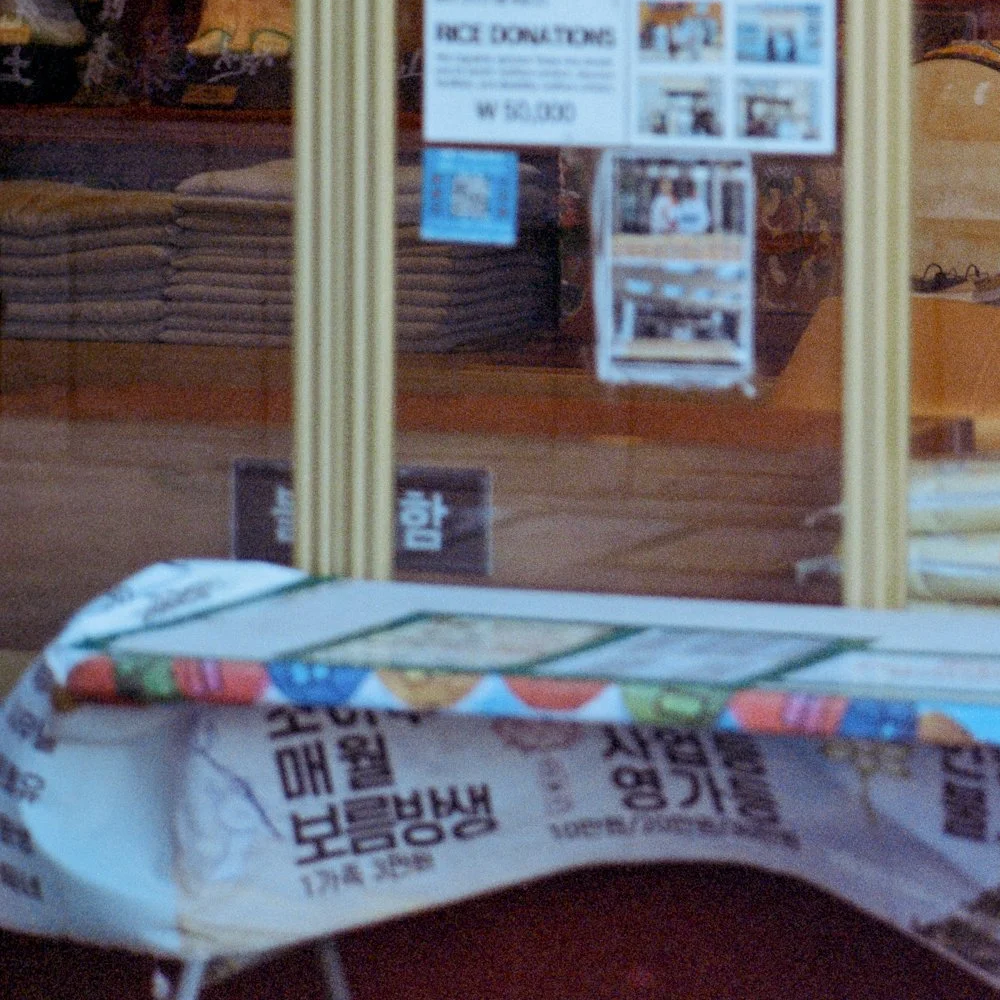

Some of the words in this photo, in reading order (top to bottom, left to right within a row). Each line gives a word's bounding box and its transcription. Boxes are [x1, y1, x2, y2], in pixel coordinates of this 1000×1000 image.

[434, 21, 481, 46] RICE
[489, 22, 617, 50] DONATIONS
[274, 732, 395, 801] 매월
[290, 783, 498, 867] 보름방생
